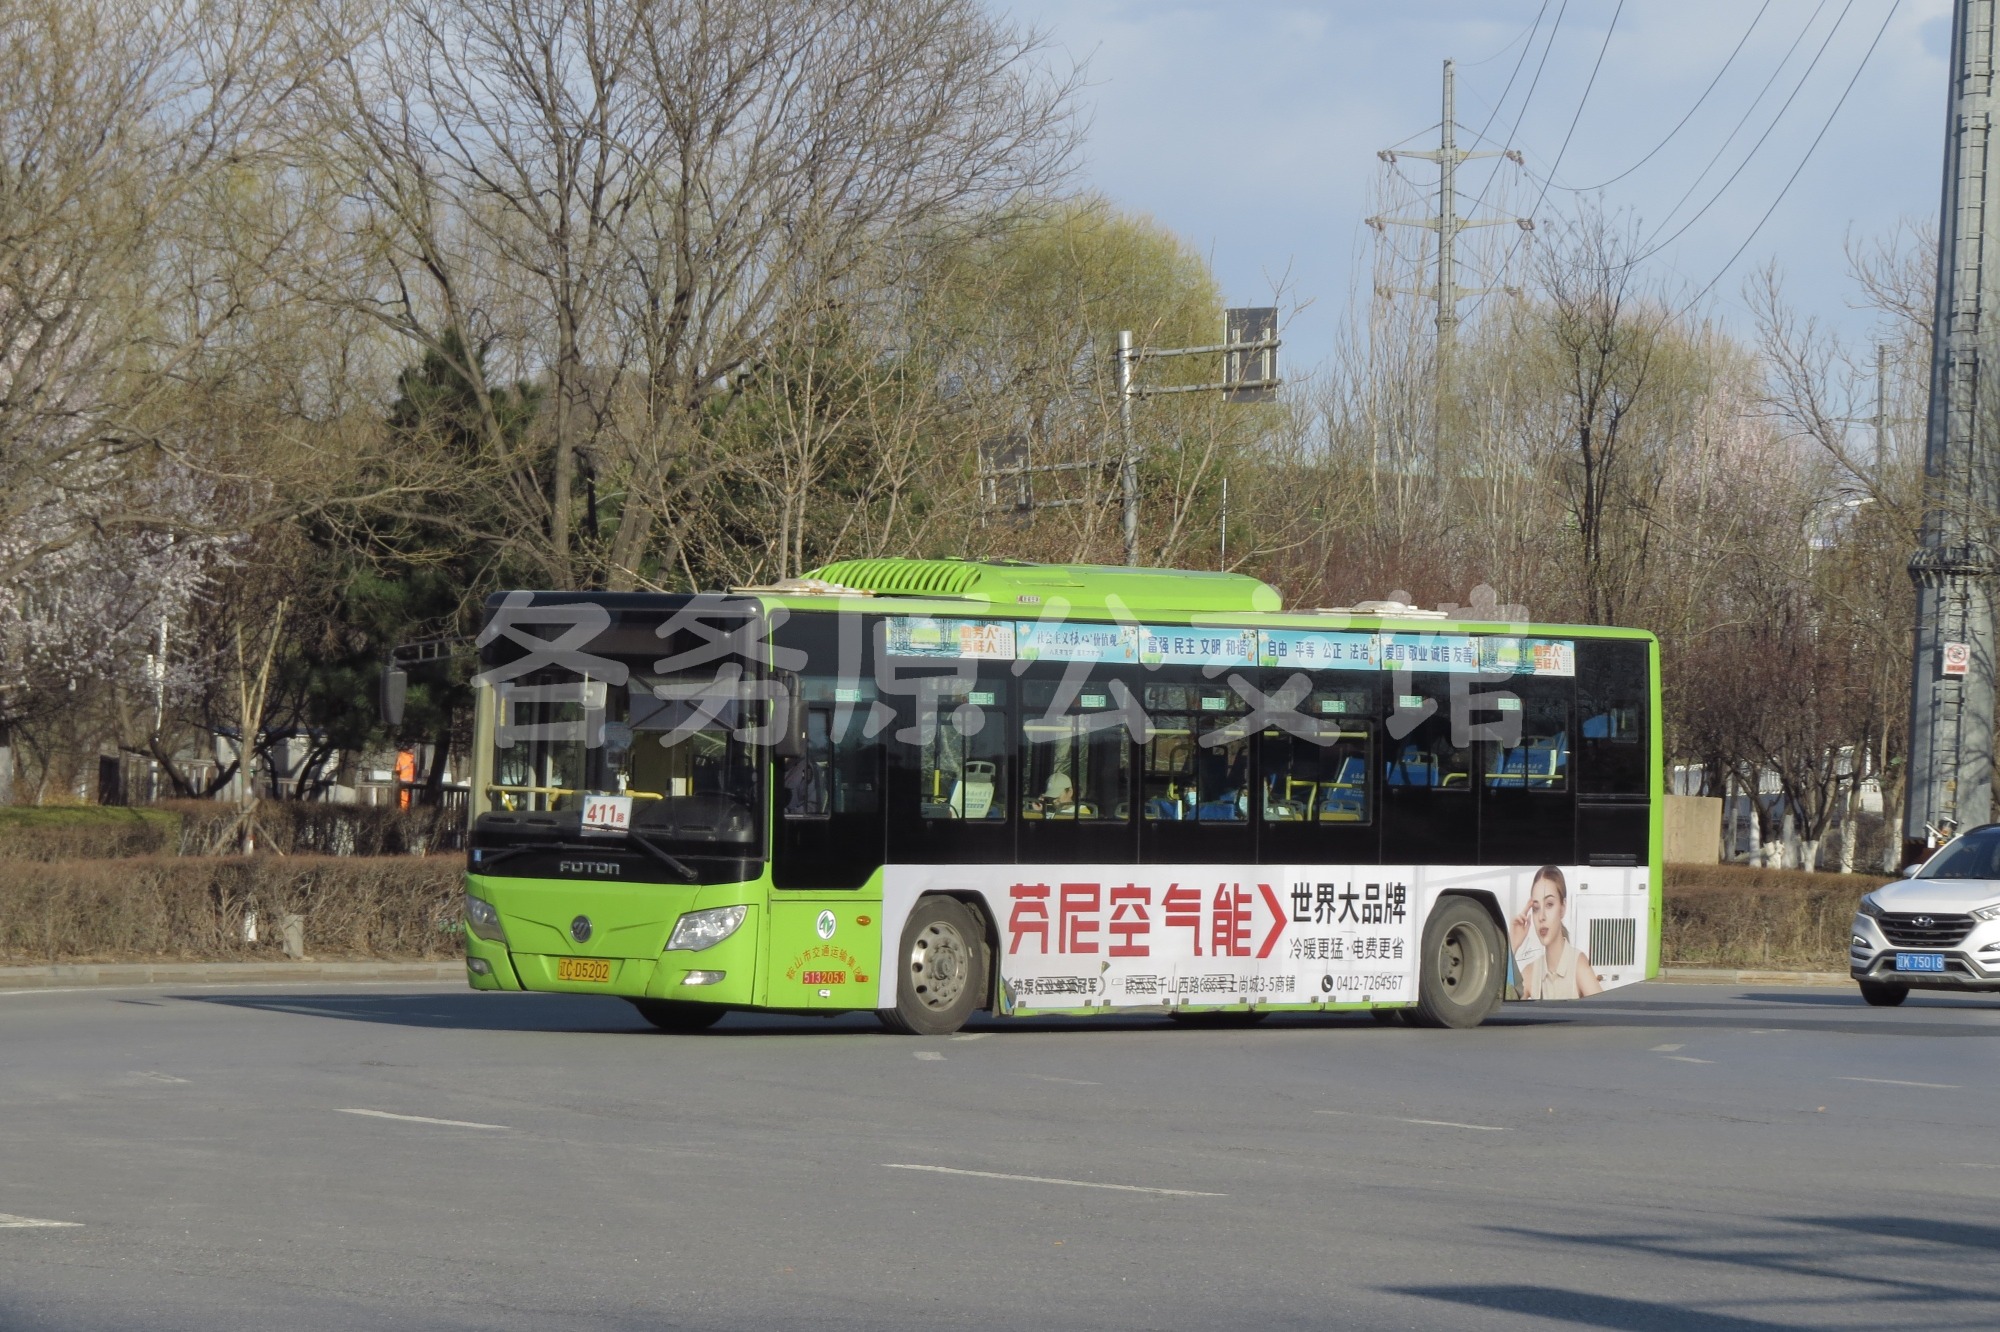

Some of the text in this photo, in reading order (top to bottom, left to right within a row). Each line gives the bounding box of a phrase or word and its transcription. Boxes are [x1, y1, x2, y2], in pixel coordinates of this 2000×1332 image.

[1148, 637, 1247, 656] 富强 民主 文明 和谐
[1268, 640, 1369, 660] 自由 平等 公正 法治
[1385, 644, 1472, 663] 爱国 敬业 诚信 友善
[560, 861, 620, 875] FOTON
[1290, 882, 1407, 925] 世界大品牌
[1008, 883, 1253, 957] 芬尼空气能
[804, 971, 845, 984] 5132053
[1336, 975, 1403, 991] 0412-7264567
